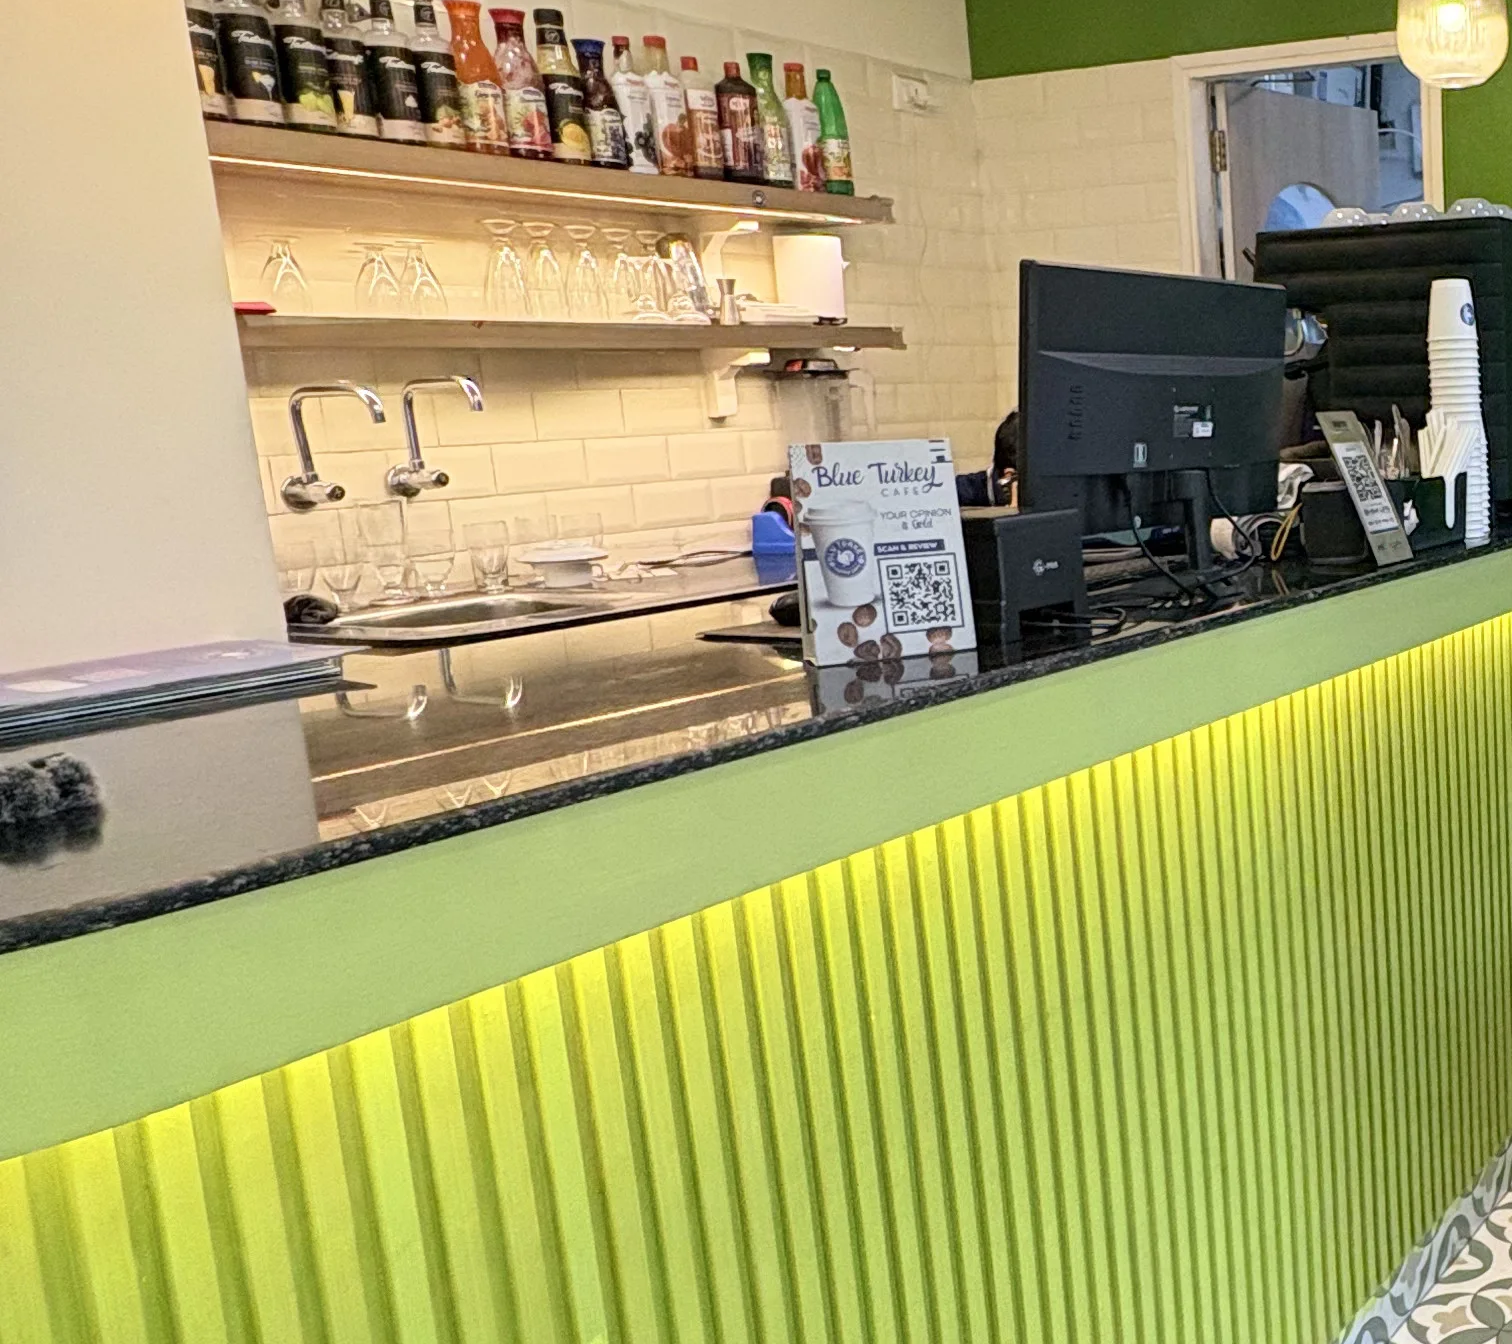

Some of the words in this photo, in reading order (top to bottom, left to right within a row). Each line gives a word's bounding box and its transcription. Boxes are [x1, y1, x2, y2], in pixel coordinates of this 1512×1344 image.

[812, 462, 864, 488] Blue
[867, 461, 943, 493] Turkey
[880, 510, 907, 520] YOUR
[876, 545, 899, 553] SCAN
[908, 542, 938, 551] REVIEW
